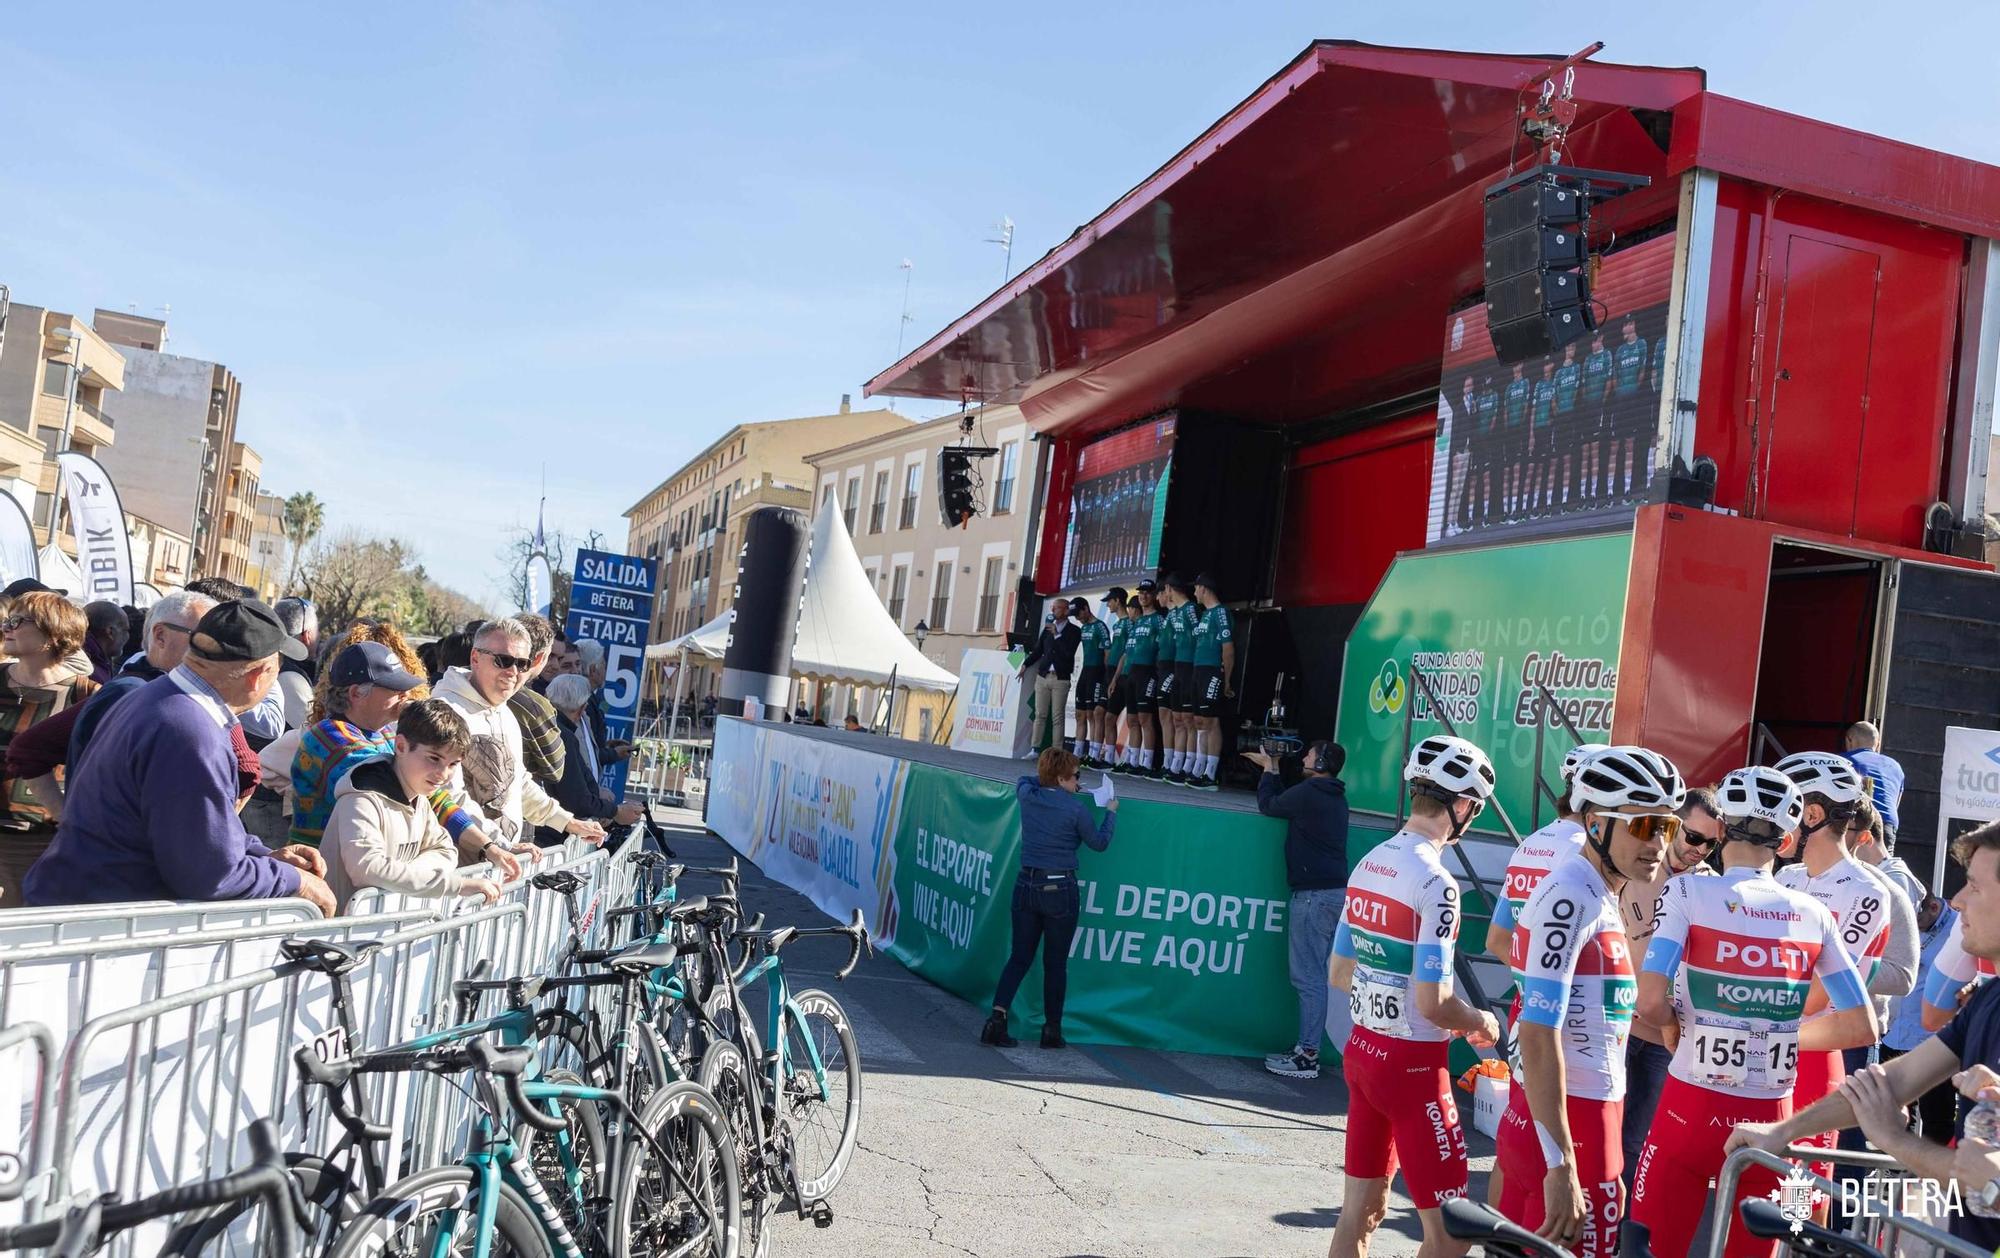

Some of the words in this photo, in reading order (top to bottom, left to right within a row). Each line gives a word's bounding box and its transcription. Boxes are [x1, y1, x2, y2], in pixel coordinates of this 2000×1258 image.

[86, 527, 119, 603] OBIK
[581, 558, 649, 589] SALIDA
[590, 591, 635, 613] BÉTERA
[578, 617, 638, 646] ETAPA
[1411, 648, 1484, 669] FUNDACIÓN
[1521, 650, 1603, 690] Cultura
[603, 646, 642, 709] 5
[1206, 676, 1219, 700] KERN
[1416, 671, 1482, 698] RINIDAD
[965, 718, 1005, 733] COMUNITAT
[1809, 758, 1841, 767] KASK
[1754, 806, 1778, 819] KASK
[915, 827, 929, 868] EL
[930, 836, 993, 897] DEPORTE
[1364, 861, 1399, 879] VisitMalta
[913, 881, 939, 931] VIVE
[940, 895, 976, 950] AQUÍ
[1115, 884, 1287, 933] DEPORTE
[1345, 895, 1388, 927] POLTI
[1436, 886, 1458, 939] solo
[1741, 906, 1803, 923] VisitMalta
[1843, 896, 1880, 945] solo
[1540, 898, 1575, 971] solo
[1152, 932, 1250, 977] AQUÍ
[1716, 940, 1809, 973] POLTI
[1368, 992, 1399, 1020] 156
[1527, 996, 1566, 1014] eolo
[1717, 983, 1801, 1008] KOMETA
[800, 1000, 848, 1034] ADEX
[1568, 984, 1595, 1059] AURUM
[1695, 1035, 1747, 1068] 155
[1769, 1043, 1799, 1071] 15
[1425, 1101, 1452, 1163] KOMETA
[1635, 1143, 1659, 1203] KOMETA
